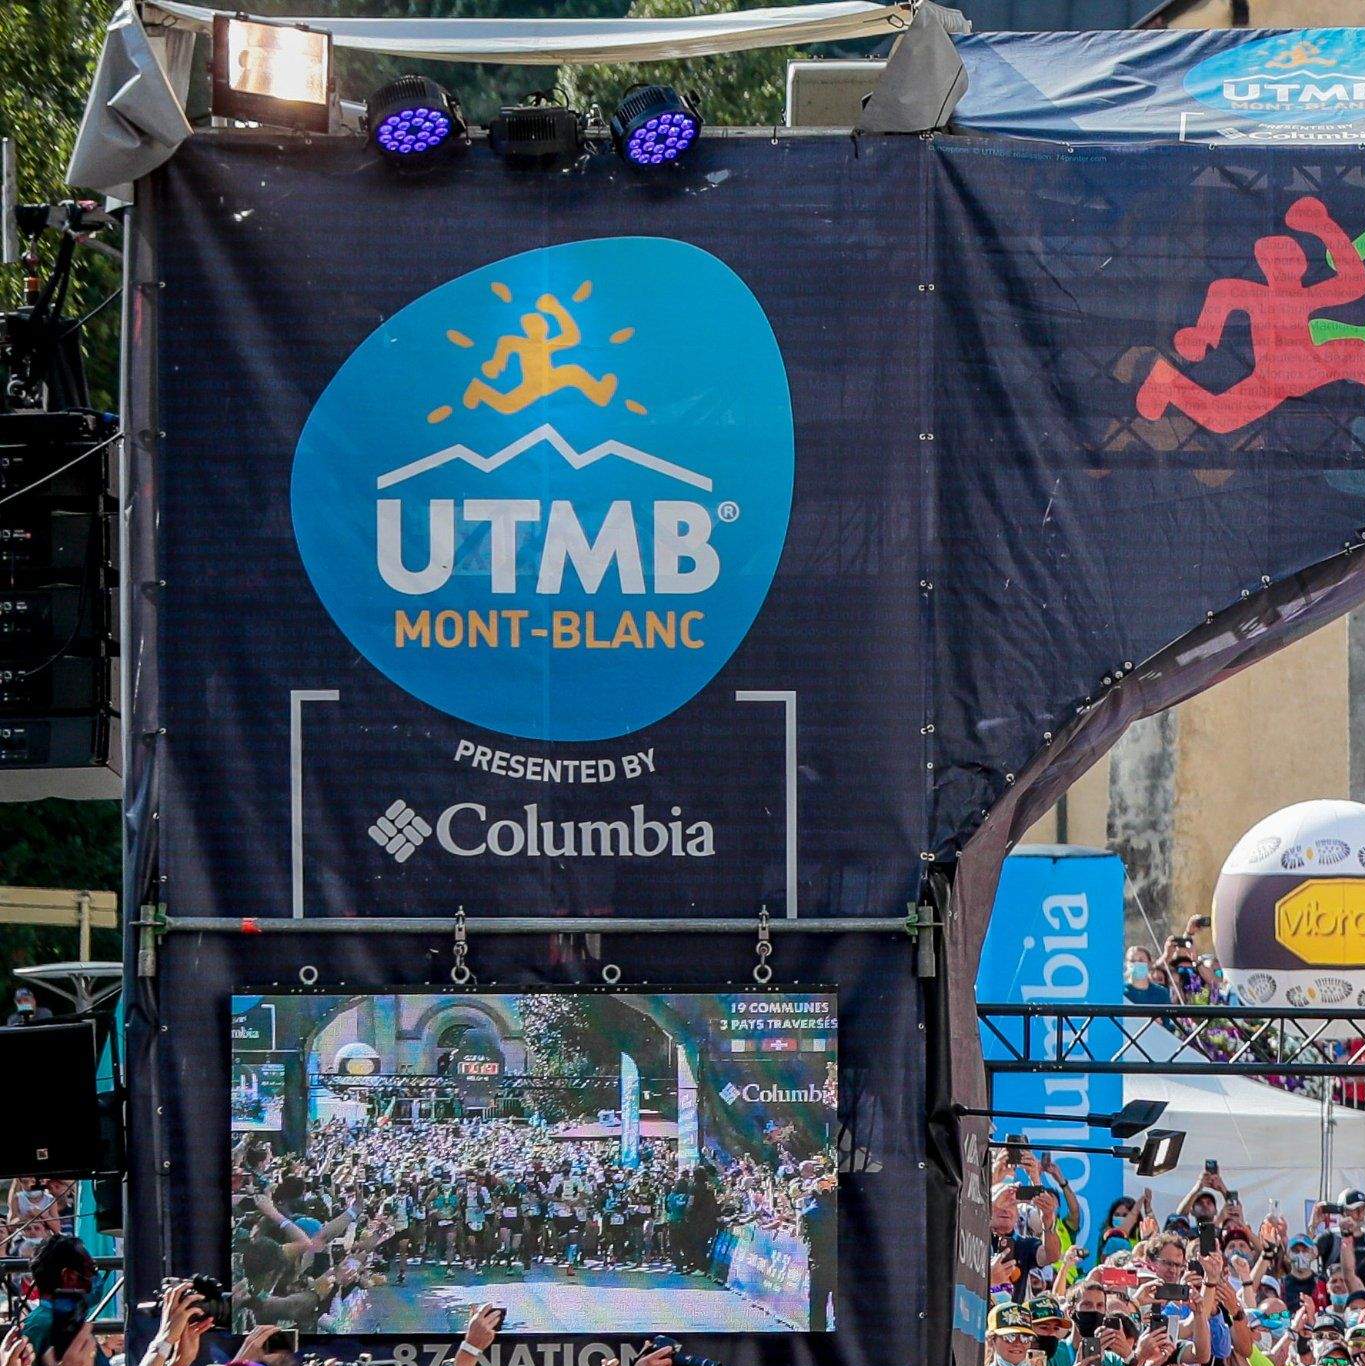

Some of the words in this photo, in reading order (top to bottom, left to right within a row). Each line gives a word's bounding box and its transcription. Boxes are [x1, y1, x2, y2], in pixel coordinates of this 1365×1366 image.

[376, 499, 721, 595] UTMB
[396, 609, 705, 650] MONT-BLANC
[454, 739, 616, 784] PRESENTED
[621, 748, 657, 779] BY
[436, 802, 716, 858] Columbia
[720, 1020, 728, 1031] 3
[731, 1019, 765, 1031] PAYS
[731, 1003, 747, 1014] 19
[749, 1002, 830, 1014] COMMUNES
